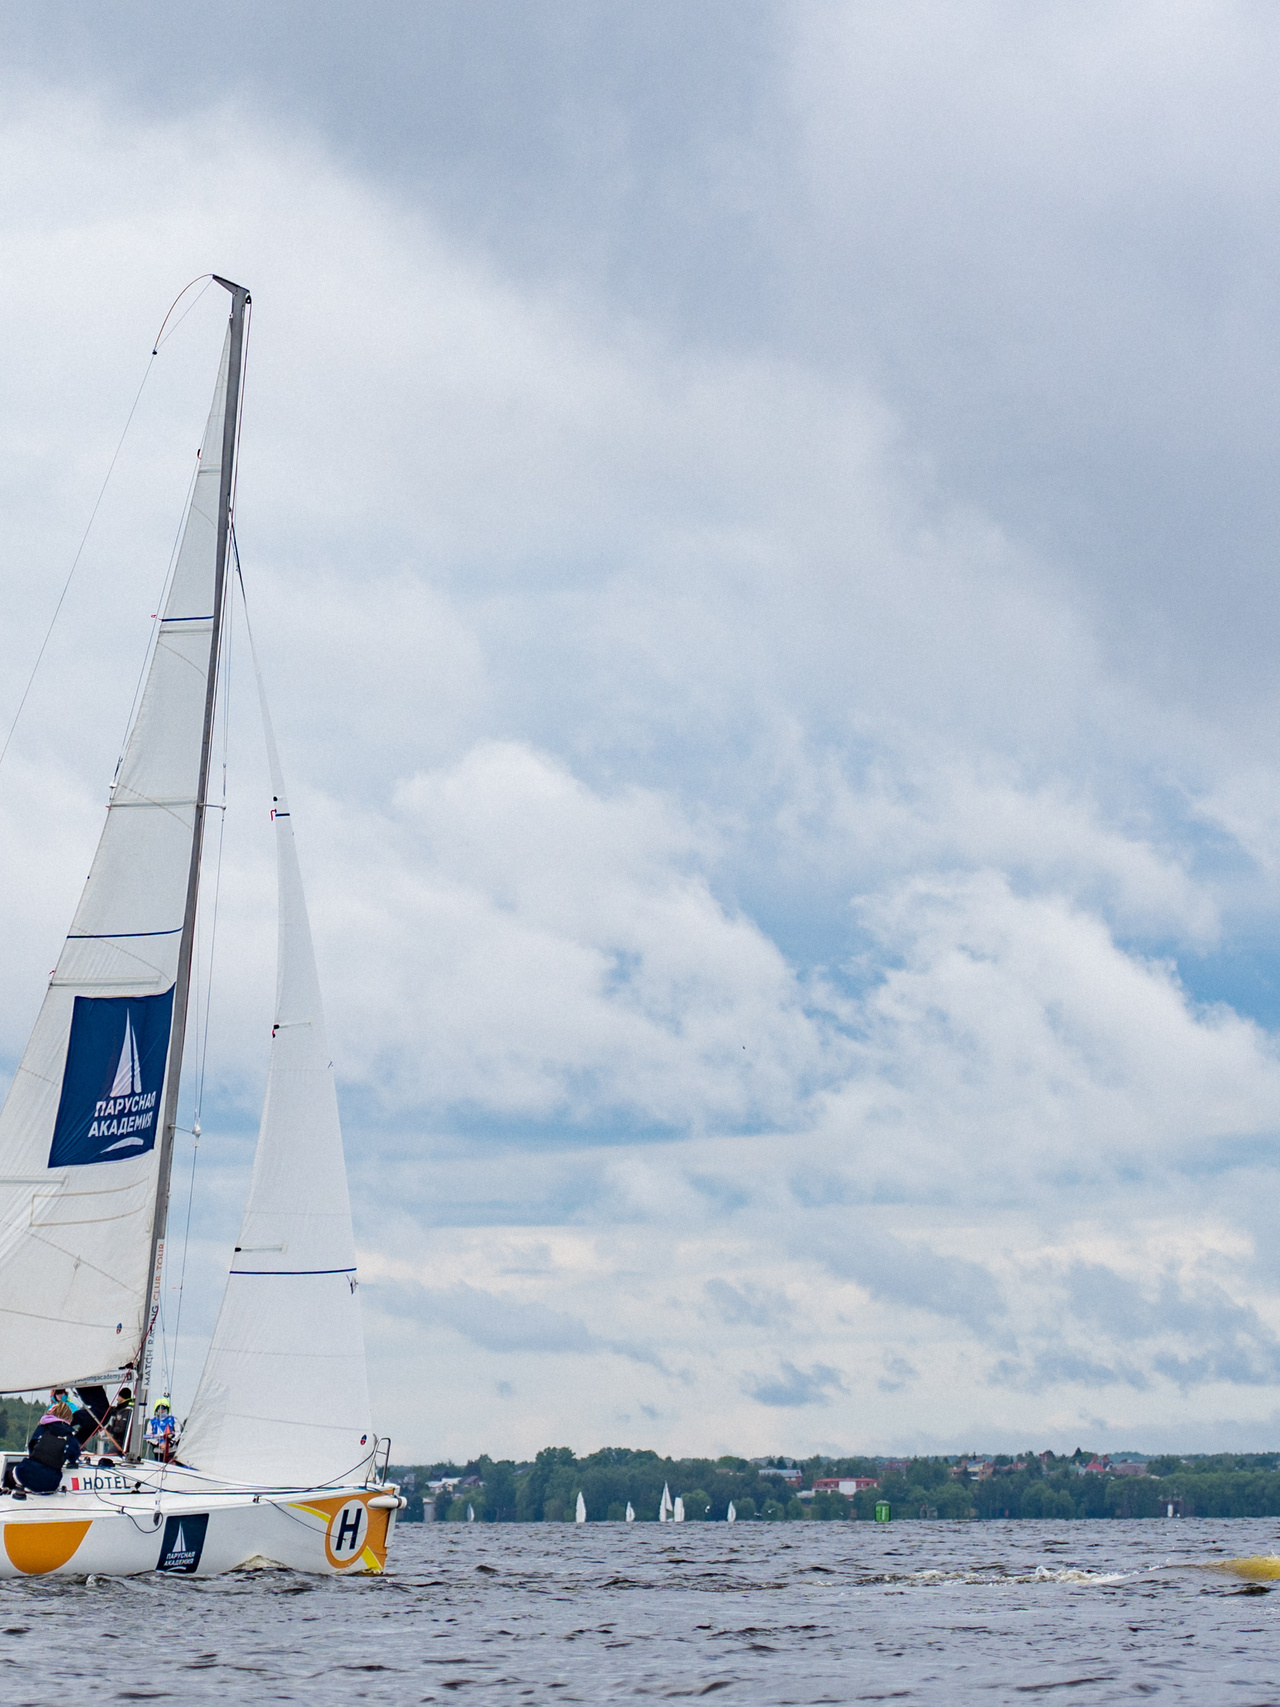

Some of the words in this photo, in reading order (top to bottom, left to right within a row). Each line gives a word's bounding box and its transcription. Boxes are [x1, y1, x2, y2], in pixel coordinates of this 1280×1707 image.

[94, 1090, 156, 1117] ПАРУСНАЯ
[87, 1111, 153, 1138] АКАДЕМИЯ
[156, 1242, 165, 1271] TOUR
[152, 1274, 161, 1302] CLUB
[143, 1349, 154, 1386] MATCH
[83, 1476, 131, 1490] HOTEL
[335, 1508, 363, 1551] H
[166, 1551, 195, 1560] ПАРУСНАЯ
